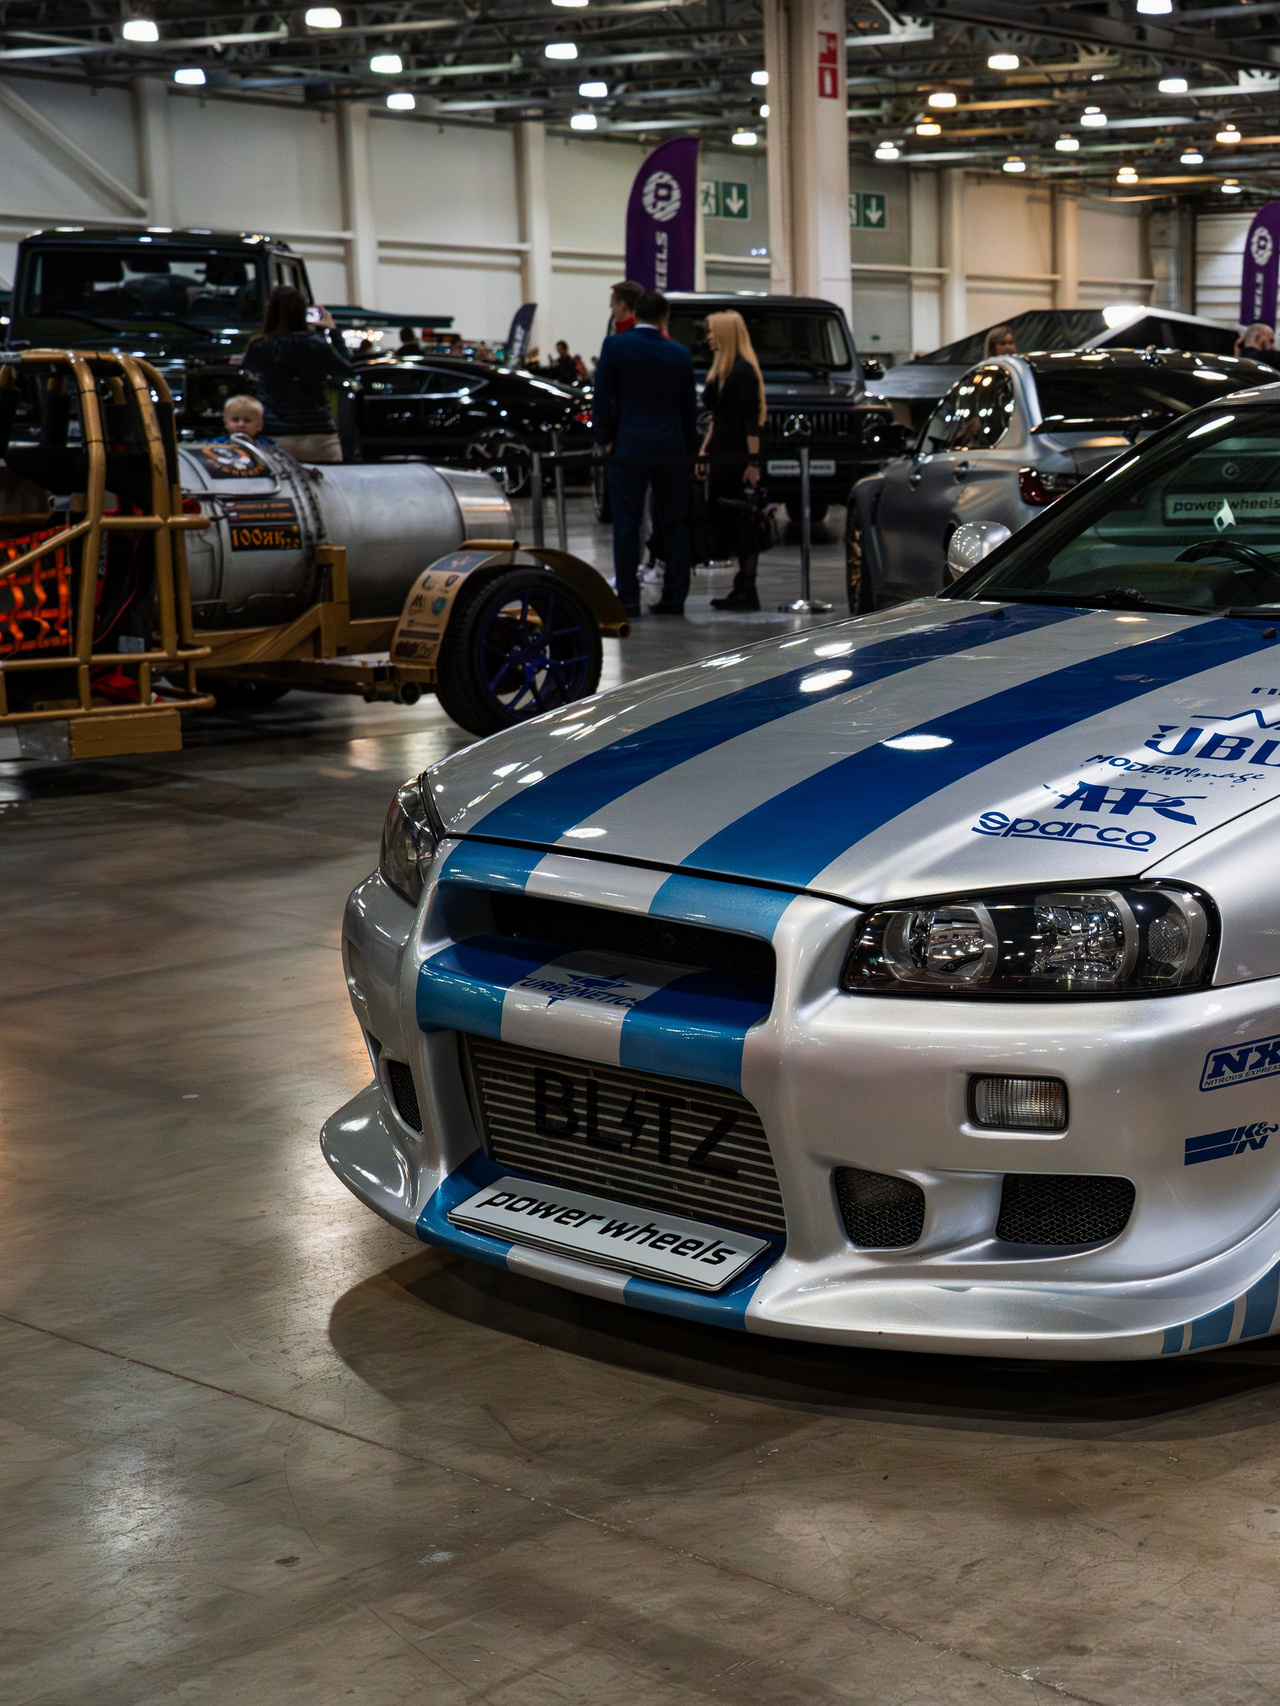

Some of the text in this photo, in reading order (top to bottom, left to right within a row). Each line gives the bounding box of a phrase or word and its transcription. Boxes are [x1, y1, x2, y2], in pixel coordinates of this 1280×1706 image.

[1203, 1073, 1243, 1087] NITROUS
[1232, 1121, 1279, 1155] K&N
[474, 1191, 737, 1266] power wheels
